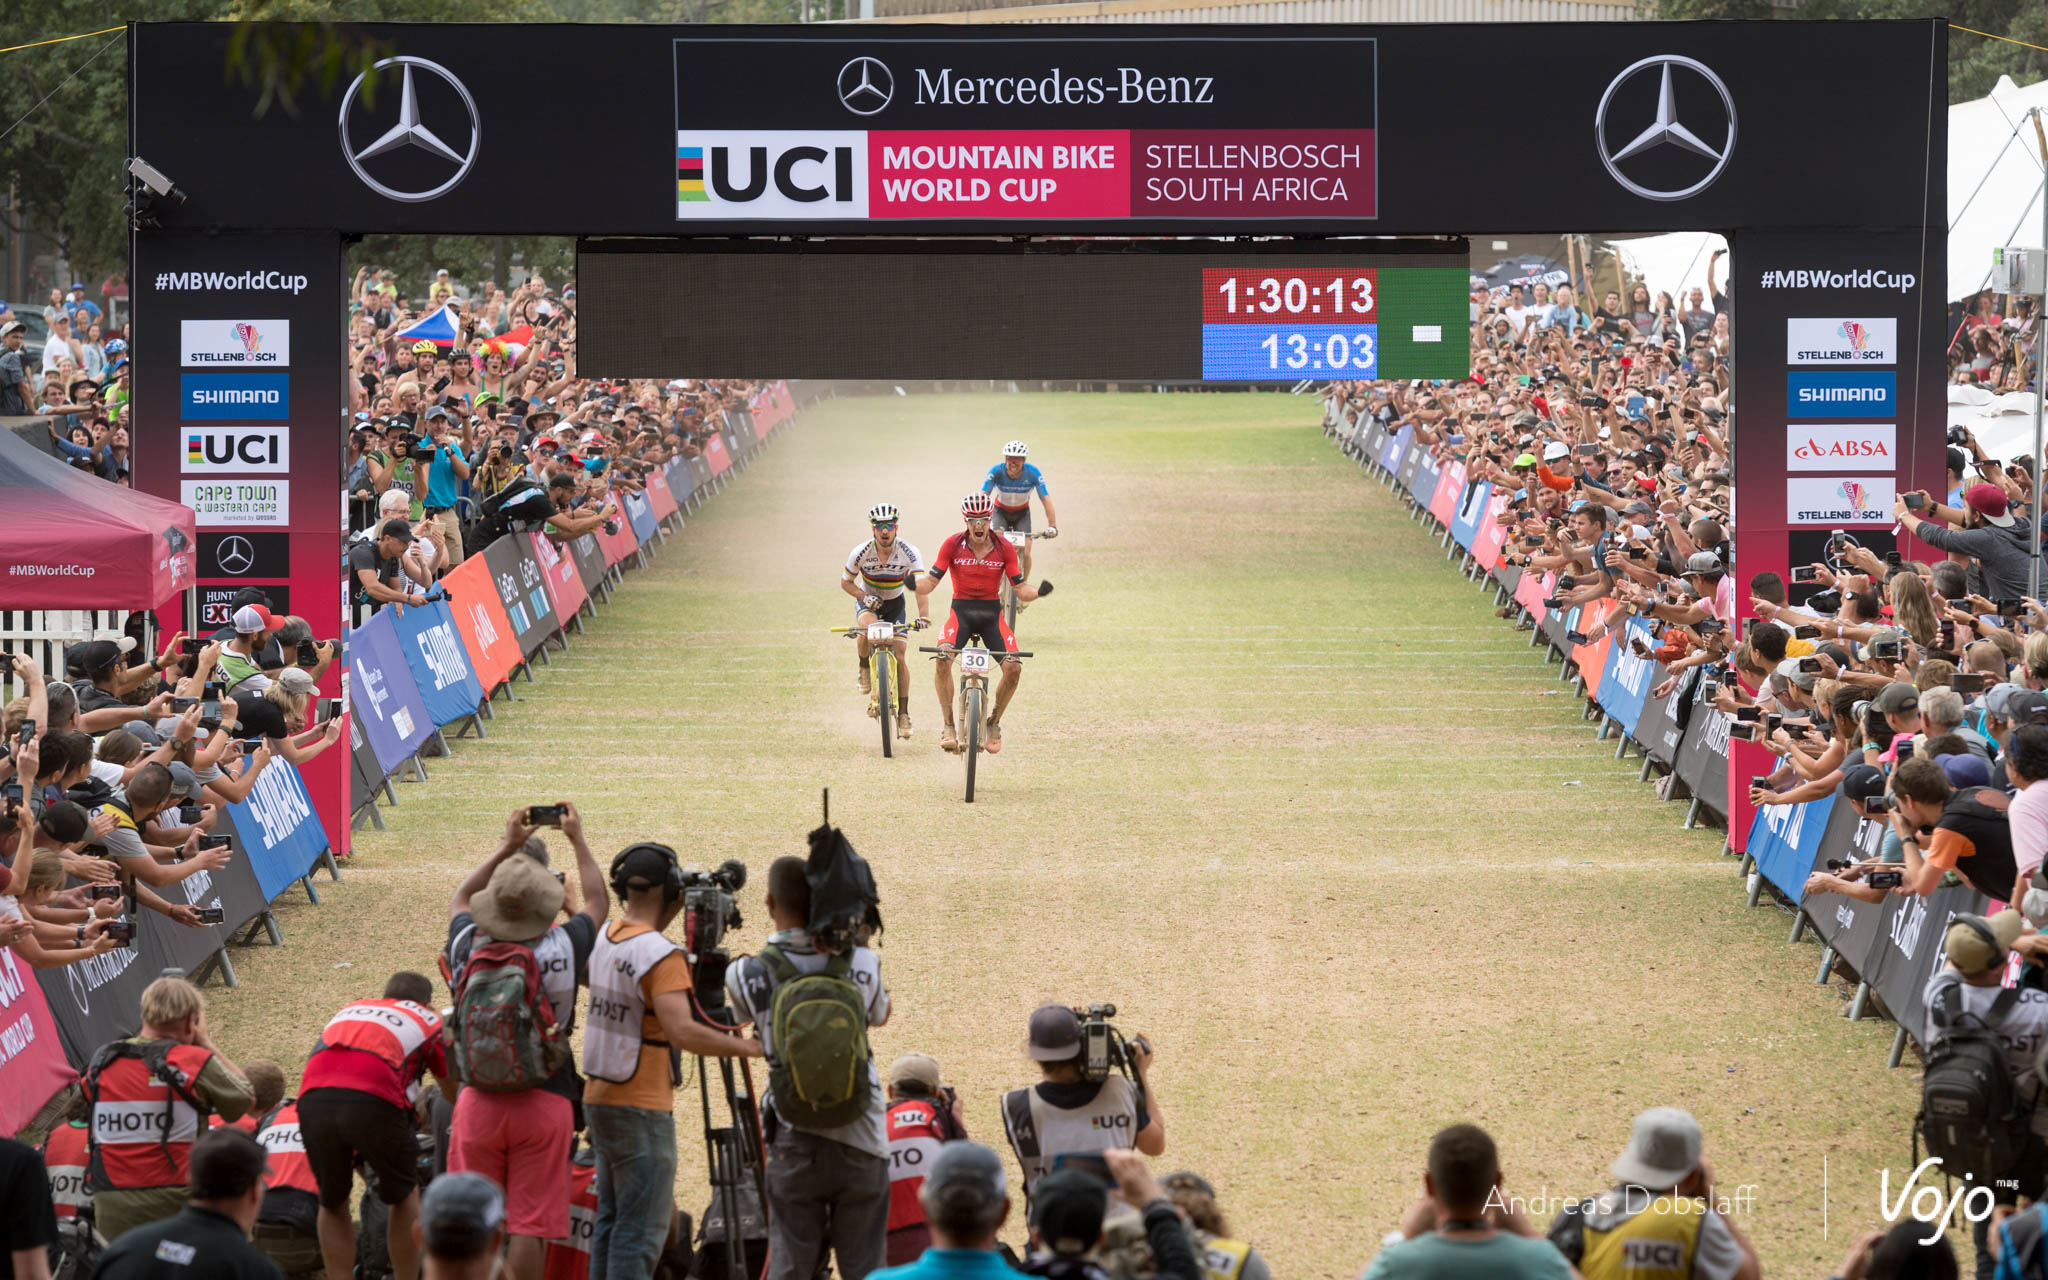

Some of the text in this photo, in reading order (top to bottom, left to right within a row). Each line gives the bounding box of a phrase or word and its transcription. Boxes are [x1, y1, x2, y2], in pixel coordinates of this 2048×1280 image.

[914, 66, 1215, 107] Mercedes-Benz
[883, 146, 1115, 170] MOUNTAIN BIKE
[1146, 145, 1360, 170] STELLENBOSCH
[710, 146, 853, 203] UCI
[883, 178, 1057, 202] WORLD CUP
[1146, 178, 1348, 202] SOUTH AFRICA
[154, 270, 308, 296] #MBWorldCup
[1760, 269, 1916, 294] #MBWorldCup
[1219, 277, 1376, 315] 1:30:13
[191, 352, 276, 362] STELLENBOSCH
[1262, 333, 1376, 370] 13:03
[1797, 350, 1884, 361] STELLENBOSCH
[192, 390, 280, 404] SHIMANO
[1799, 387, 1886, 402] SHIMANO
[205, 434, 278, 465] UCI
[1829, 440, 1888, 458] ABSA
[195, 485, 277, 501] CAPE TOWN
[204, 503, 249, 513] WESTERN
[252, 503, 277, 513] CAPE
[1797, 510, 1883, 520] STELLENBOSCH
[9, 565, 95, 579] #MBWorldCup
[206, 591, 237, 603] HUNT
[202, 603, 233, 624] EXT
[965, 654, 986, 667] 30
